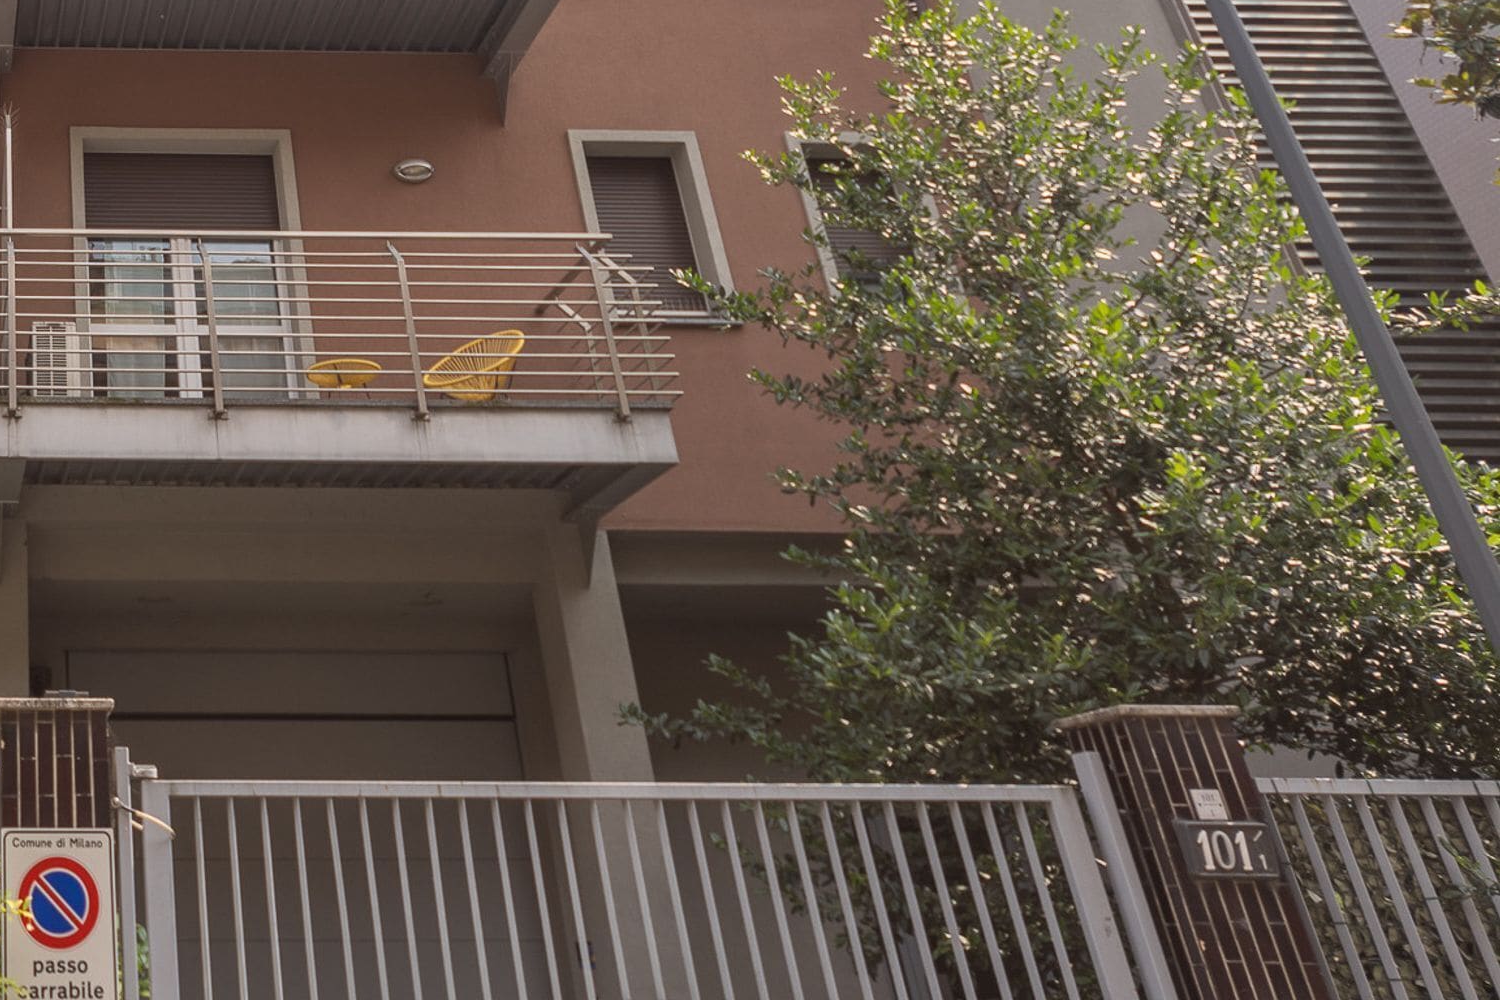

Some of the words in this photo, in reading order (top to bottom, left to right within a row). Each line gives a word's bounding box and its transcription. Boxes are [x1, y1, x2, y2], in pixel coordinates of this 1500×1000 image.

[11, 837, 53, 848] Comune
[56, 838, 66, 848] di
[69, 838, 103, 848] Milano
[33, 959, 88, 977] passo
[17, 981, 104, 999] carrabile
